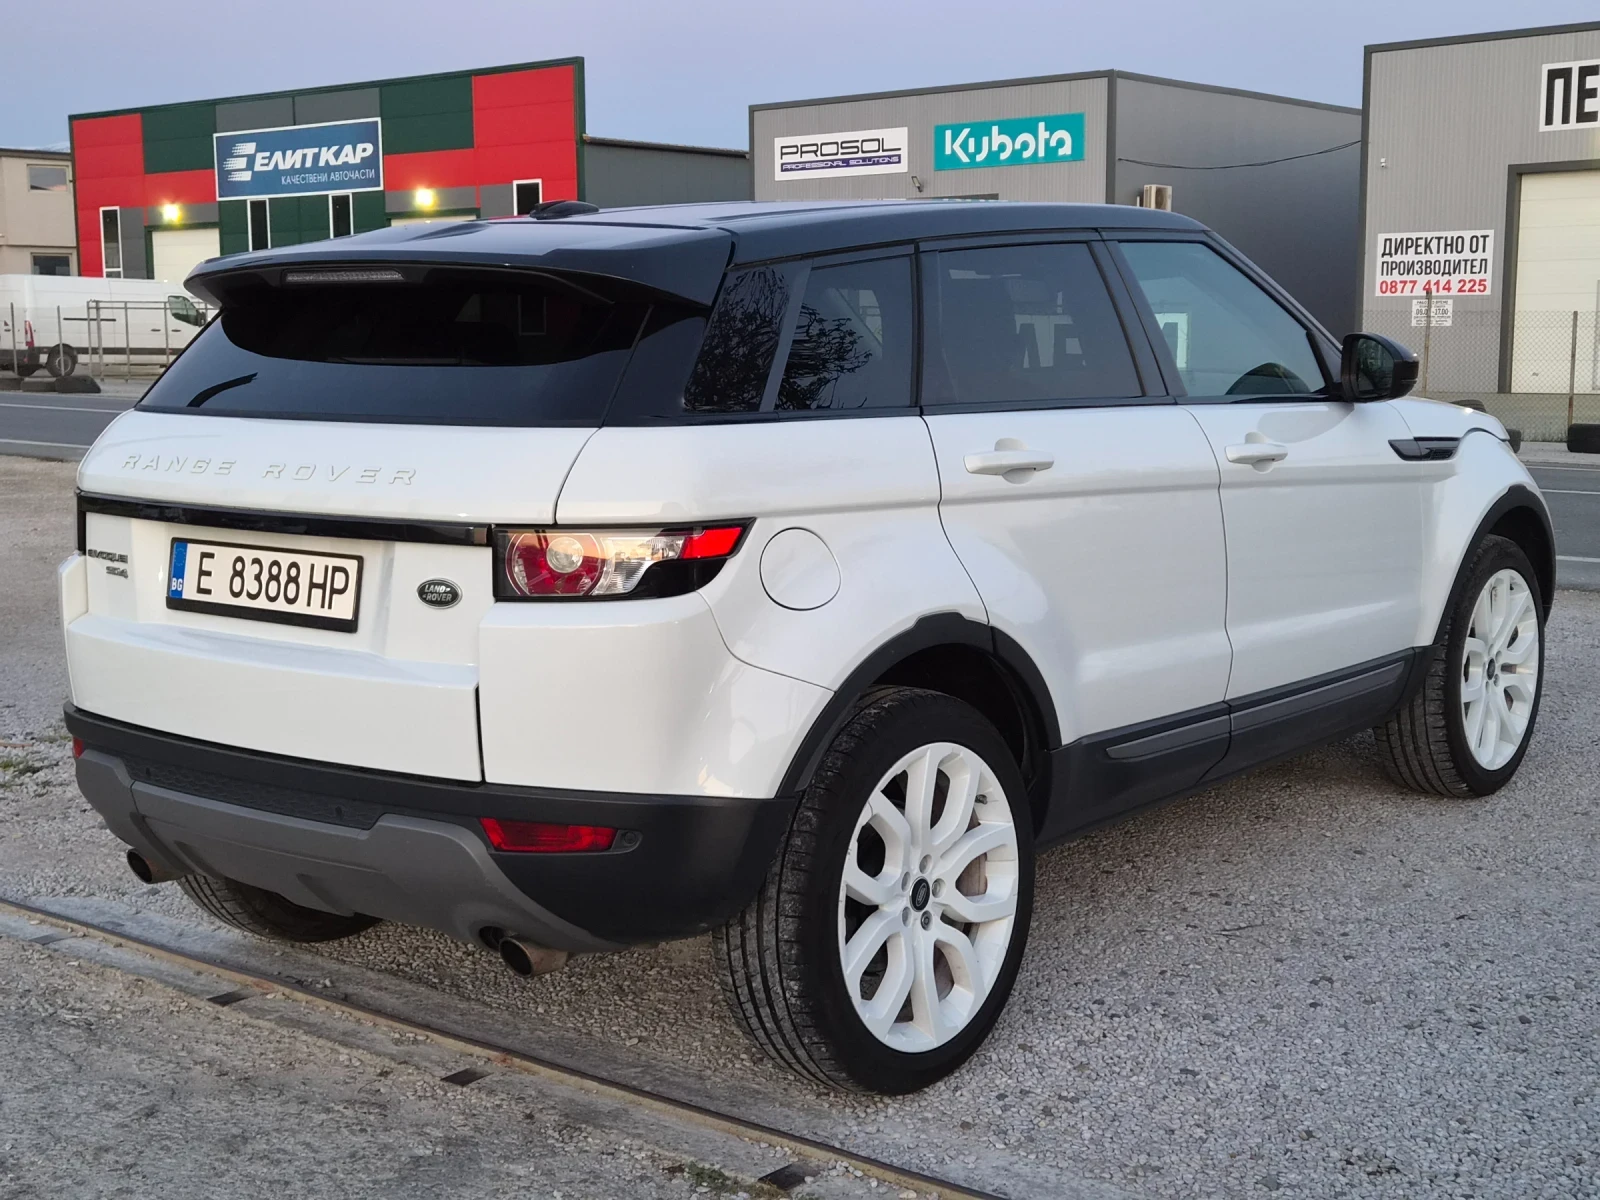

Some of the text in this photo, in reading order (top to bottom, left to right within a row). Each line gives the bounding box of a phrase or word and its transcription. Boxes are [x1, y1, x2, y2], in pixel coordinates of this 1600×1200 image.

[1545, 65, 1600, 126] ПЕ
[780, 138, 901, 160] PROSOL
[945, 121, 1072, 163] Kubota
[849, 156, 899, 165] SOLUTIONS
[281, 169, 375, 185] КАЧЕСТВЕНИ АВТОЧАСТИ
[1381, 235, 1490, 258] ДИРЕКТНО ОТ
[1381, 258, 1488, 277] ПРОИЗВОДИТЕЛ
[1380, 278, 1487, 294] 0877 414 225
[122, 454, 416, 485] RANGE ROVER
[171, 577, 183, 591] BG
[196, 551, 350, 610] E 8388 HP
[424, 584, 446, 593] LAND
[426, 593, 452, 601] ROVER
